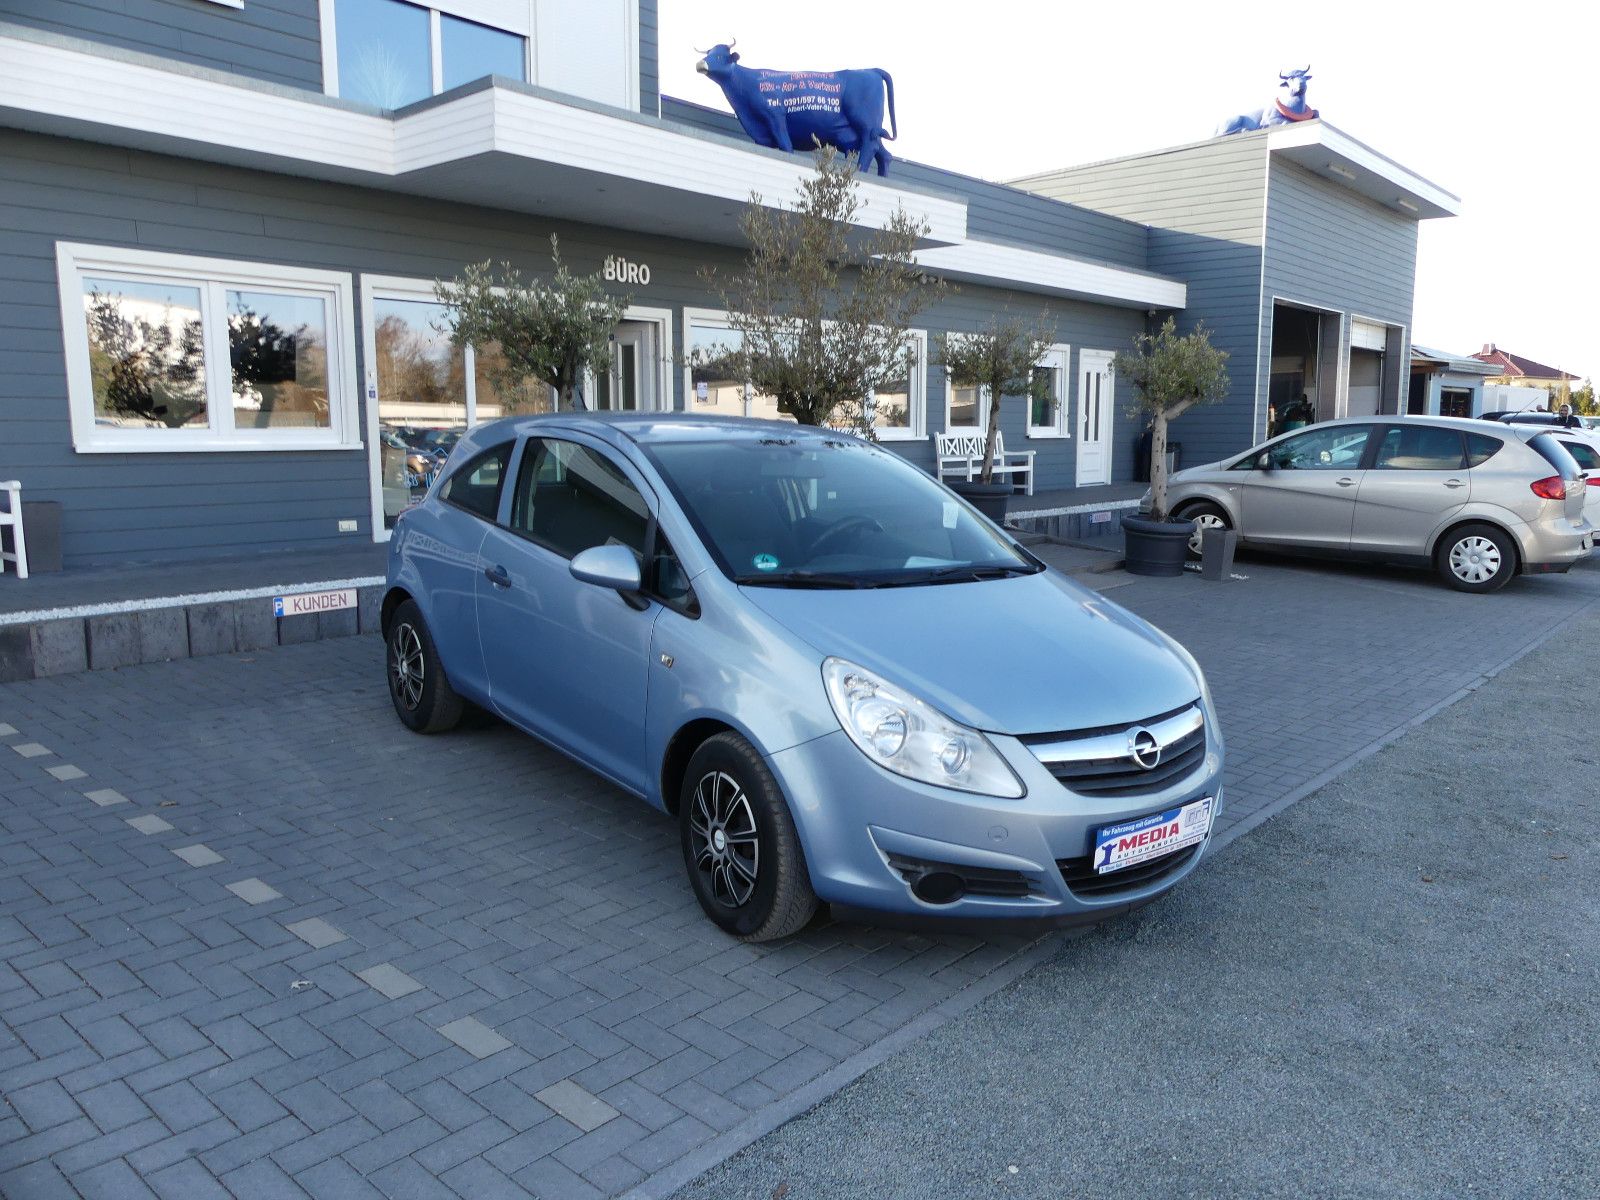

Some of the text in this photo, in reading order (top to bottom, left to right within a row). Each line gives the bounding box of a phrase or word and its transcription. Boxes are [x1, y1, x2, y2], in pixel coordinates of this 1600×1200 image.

[768, 98, 782, 107] Tel.
[604, 256, 651, 285] BÜRO
[293, 592, 348, 612] KUNDEN
[1118, 822, 1180, 853] MEDIA
